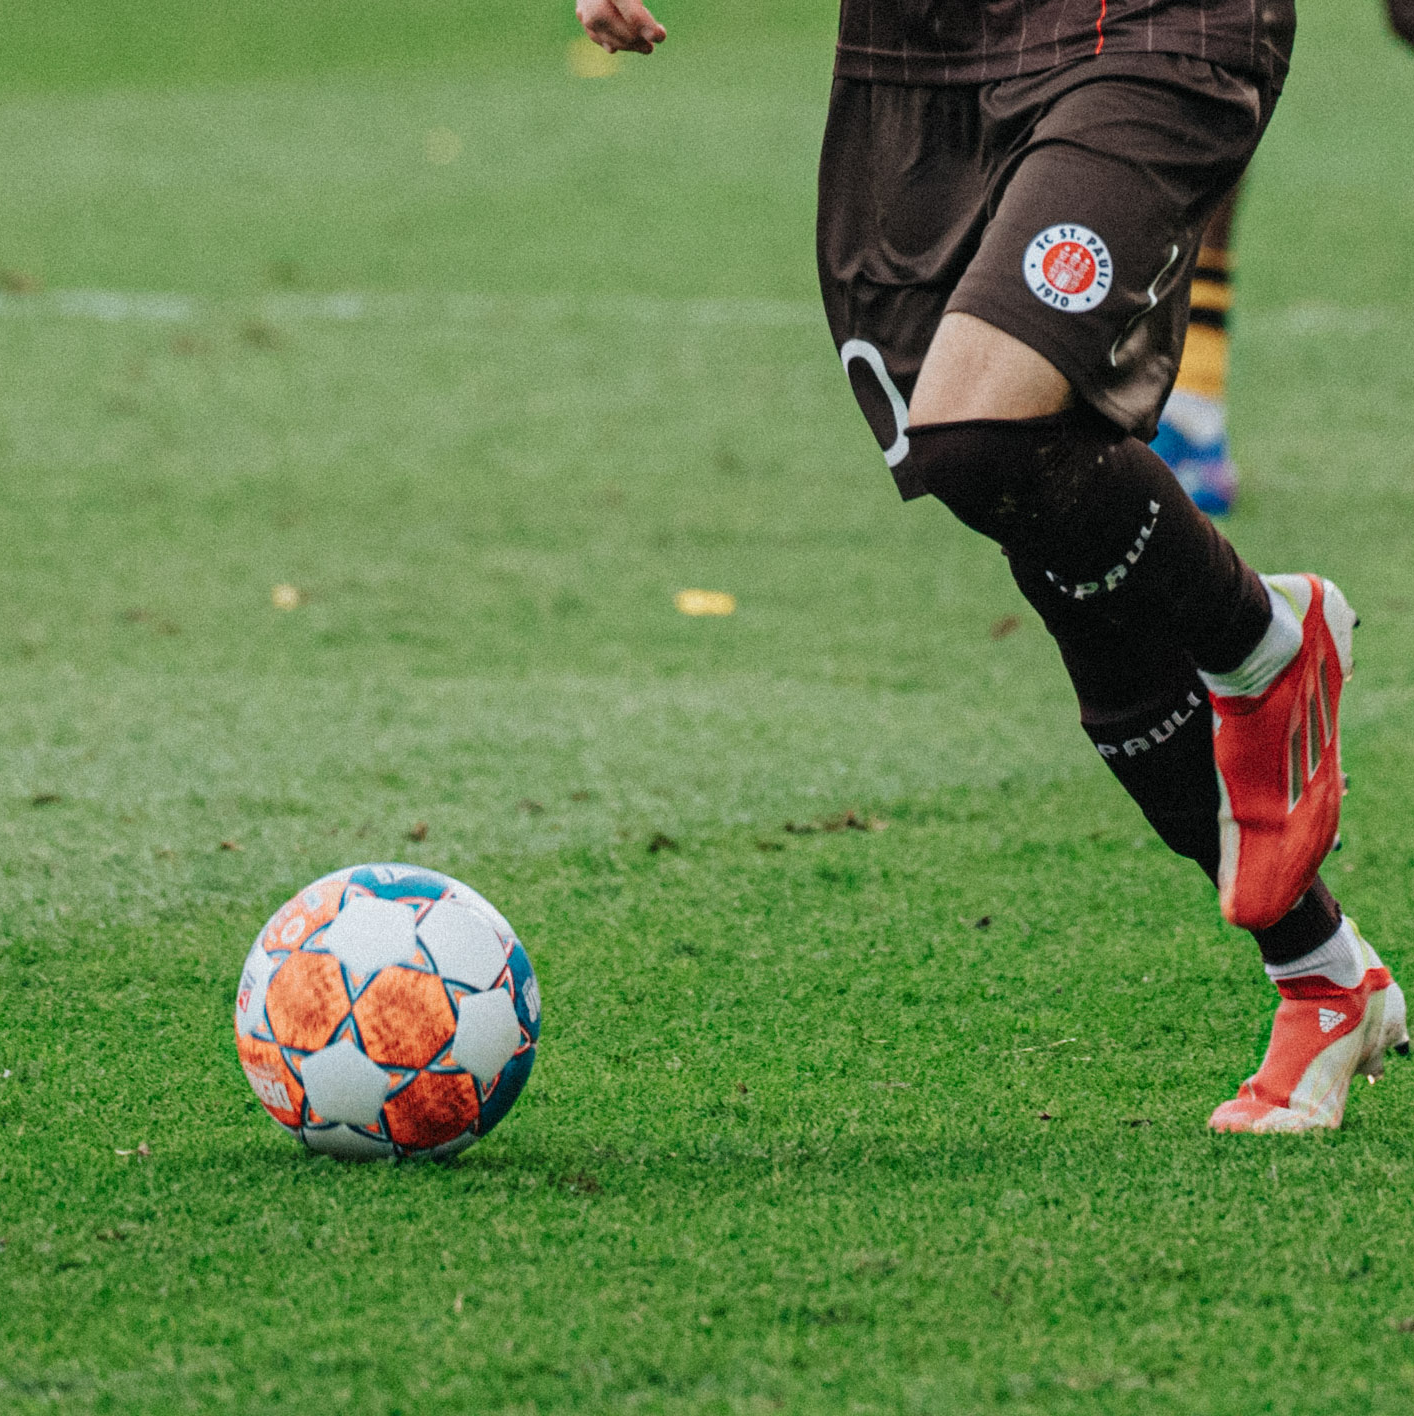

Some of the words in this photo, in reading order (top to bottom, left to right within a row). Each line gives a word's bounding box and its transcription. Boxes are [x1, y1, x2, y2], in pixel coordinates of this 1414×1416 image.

[1035, 233, 1054, 251] FC
[1059, 228, 1081, 241] ST.
[1087, 236, 1110, 289] PAULI
[1036, 282, 1070, 308] 1910
